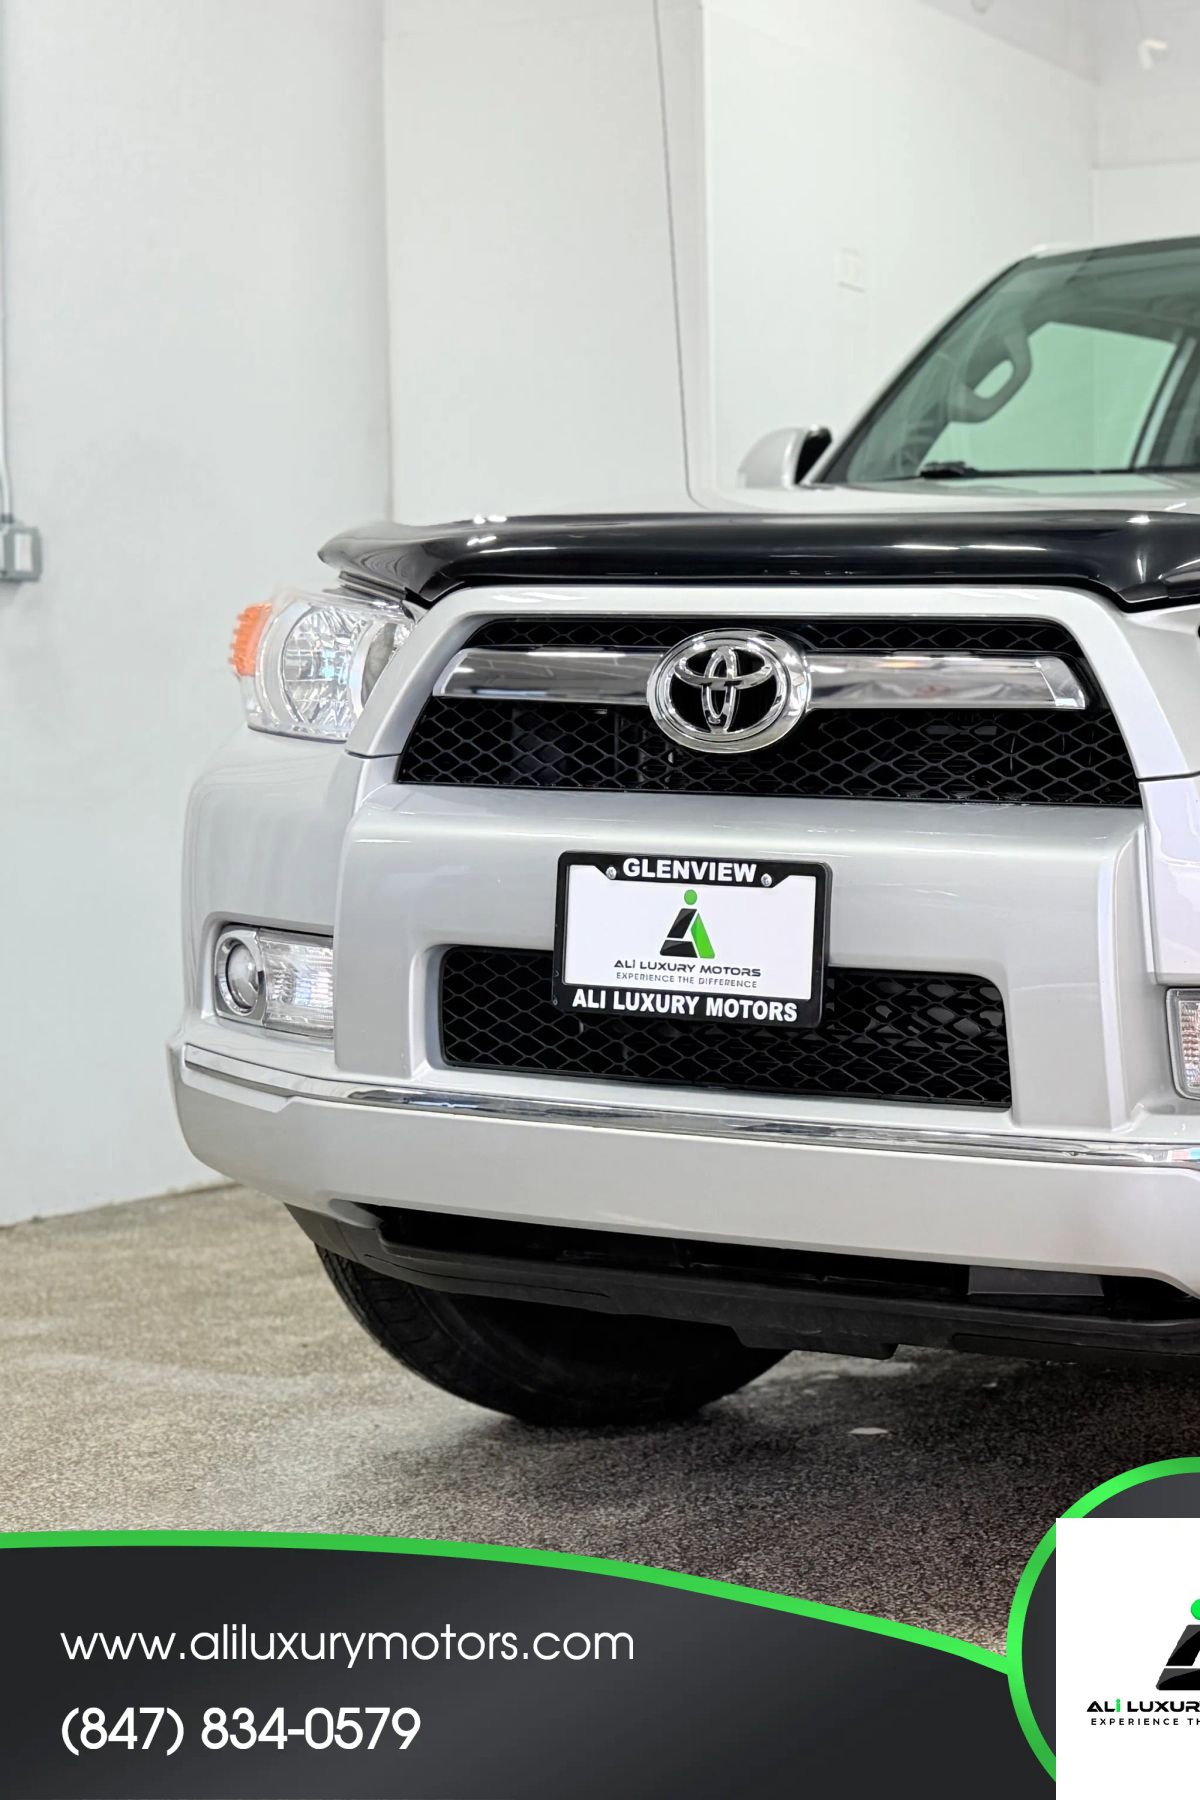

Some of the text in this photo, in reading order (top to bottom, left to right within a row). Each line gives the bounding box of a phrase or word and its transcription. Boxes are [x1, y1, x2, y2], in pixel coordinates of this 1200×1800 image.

[622, 857, 757, 883] GLENVIEW
[616, 971, 758, 988] EXPERIENCE THE DIFFERENCE
[639, 961, 696, 973] LUXURY
[699, 965, 762, 977] MOTORS
[572, 988, 798, 1023] ALI LUXURY MOTORS
